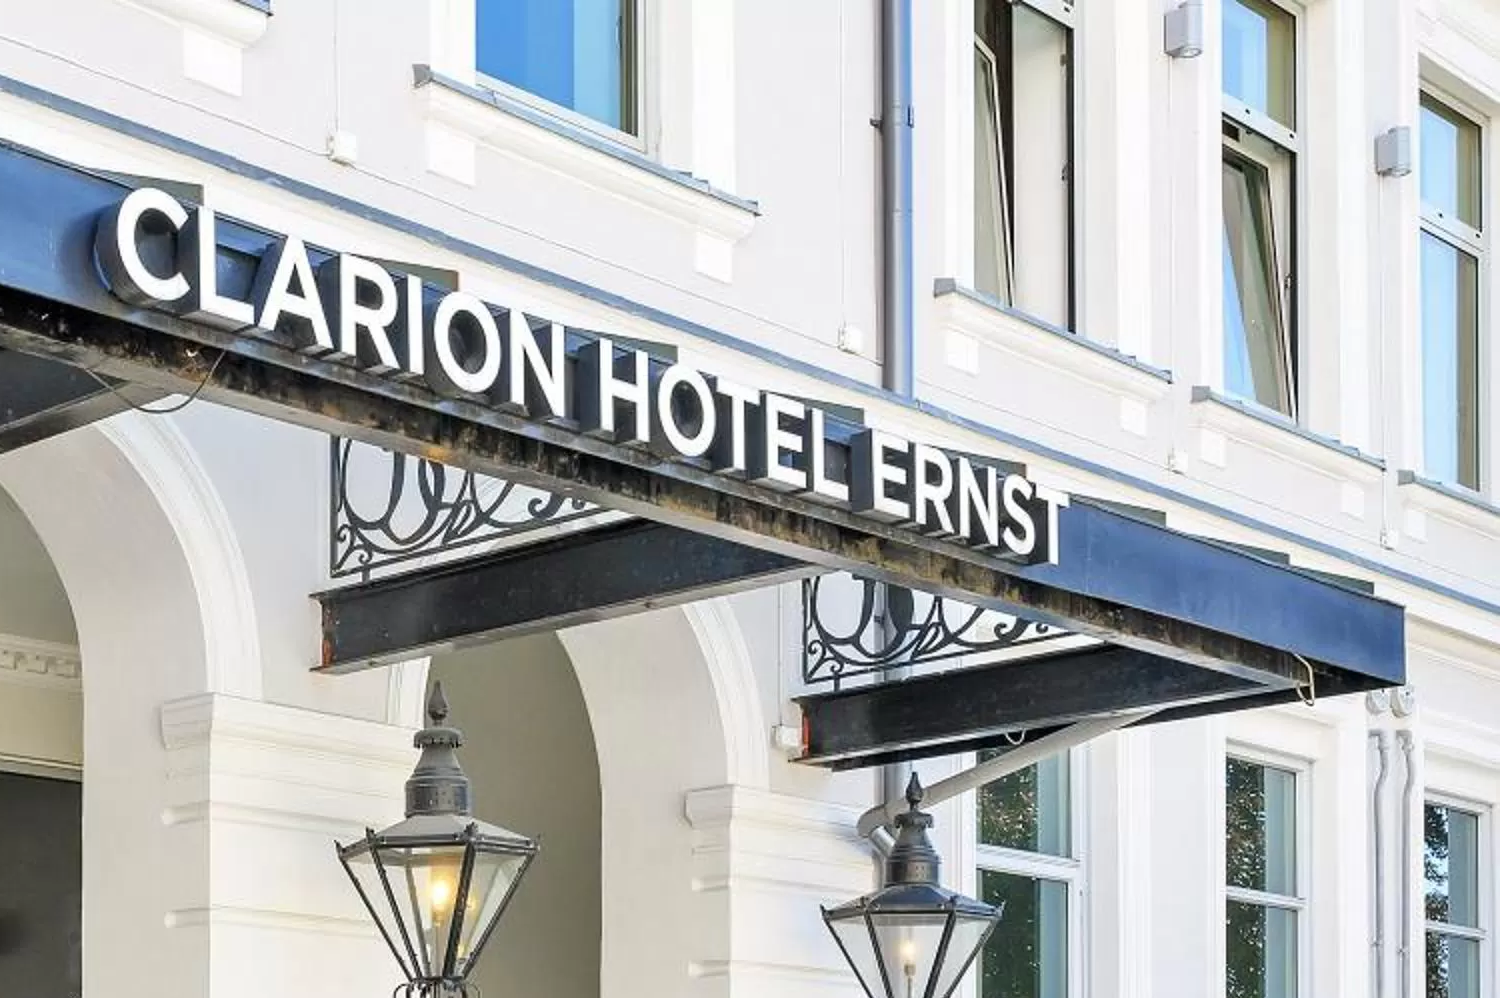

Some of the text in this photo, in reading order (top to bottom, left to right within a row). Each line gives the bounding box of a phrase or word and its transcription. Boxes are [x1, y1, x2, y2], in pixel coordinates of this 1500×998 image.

[117, 187, 1071, 566] CLARION HOTEL ERNST
